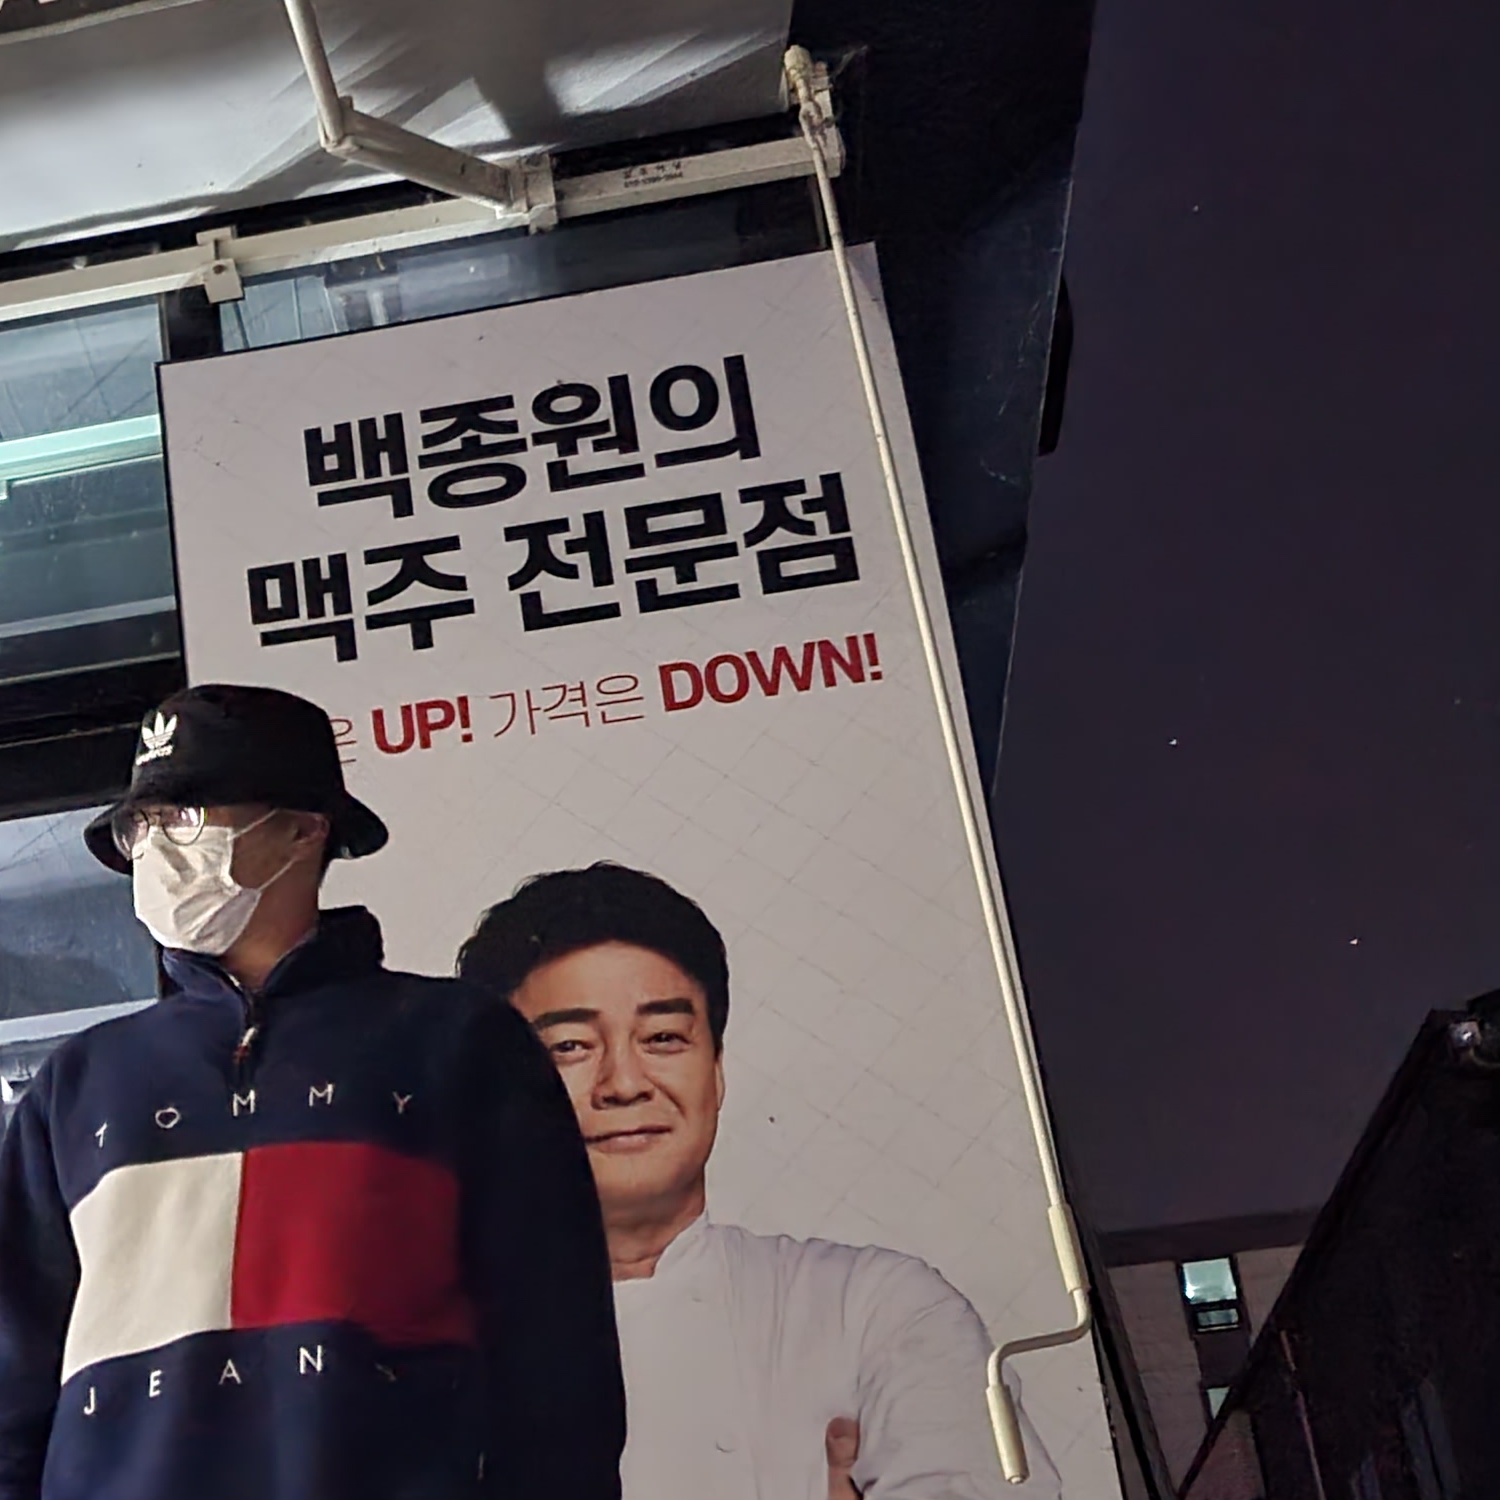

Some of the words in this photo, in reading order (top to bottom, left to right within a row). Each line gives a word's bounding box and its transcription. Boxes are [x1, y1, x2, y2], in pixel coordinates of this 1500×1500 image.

[303, 354, 760, 519] 백종원의
[247, 535, 475, 662] 맥주
[504, 472, 860, 633] 전문점
[373, 695, 473, 754] UP!
[490, 672, 644, 738] 가격은
[658, 632, 882, 712] DOWN!
[94, 1083, 412, 1148] TOMMY
